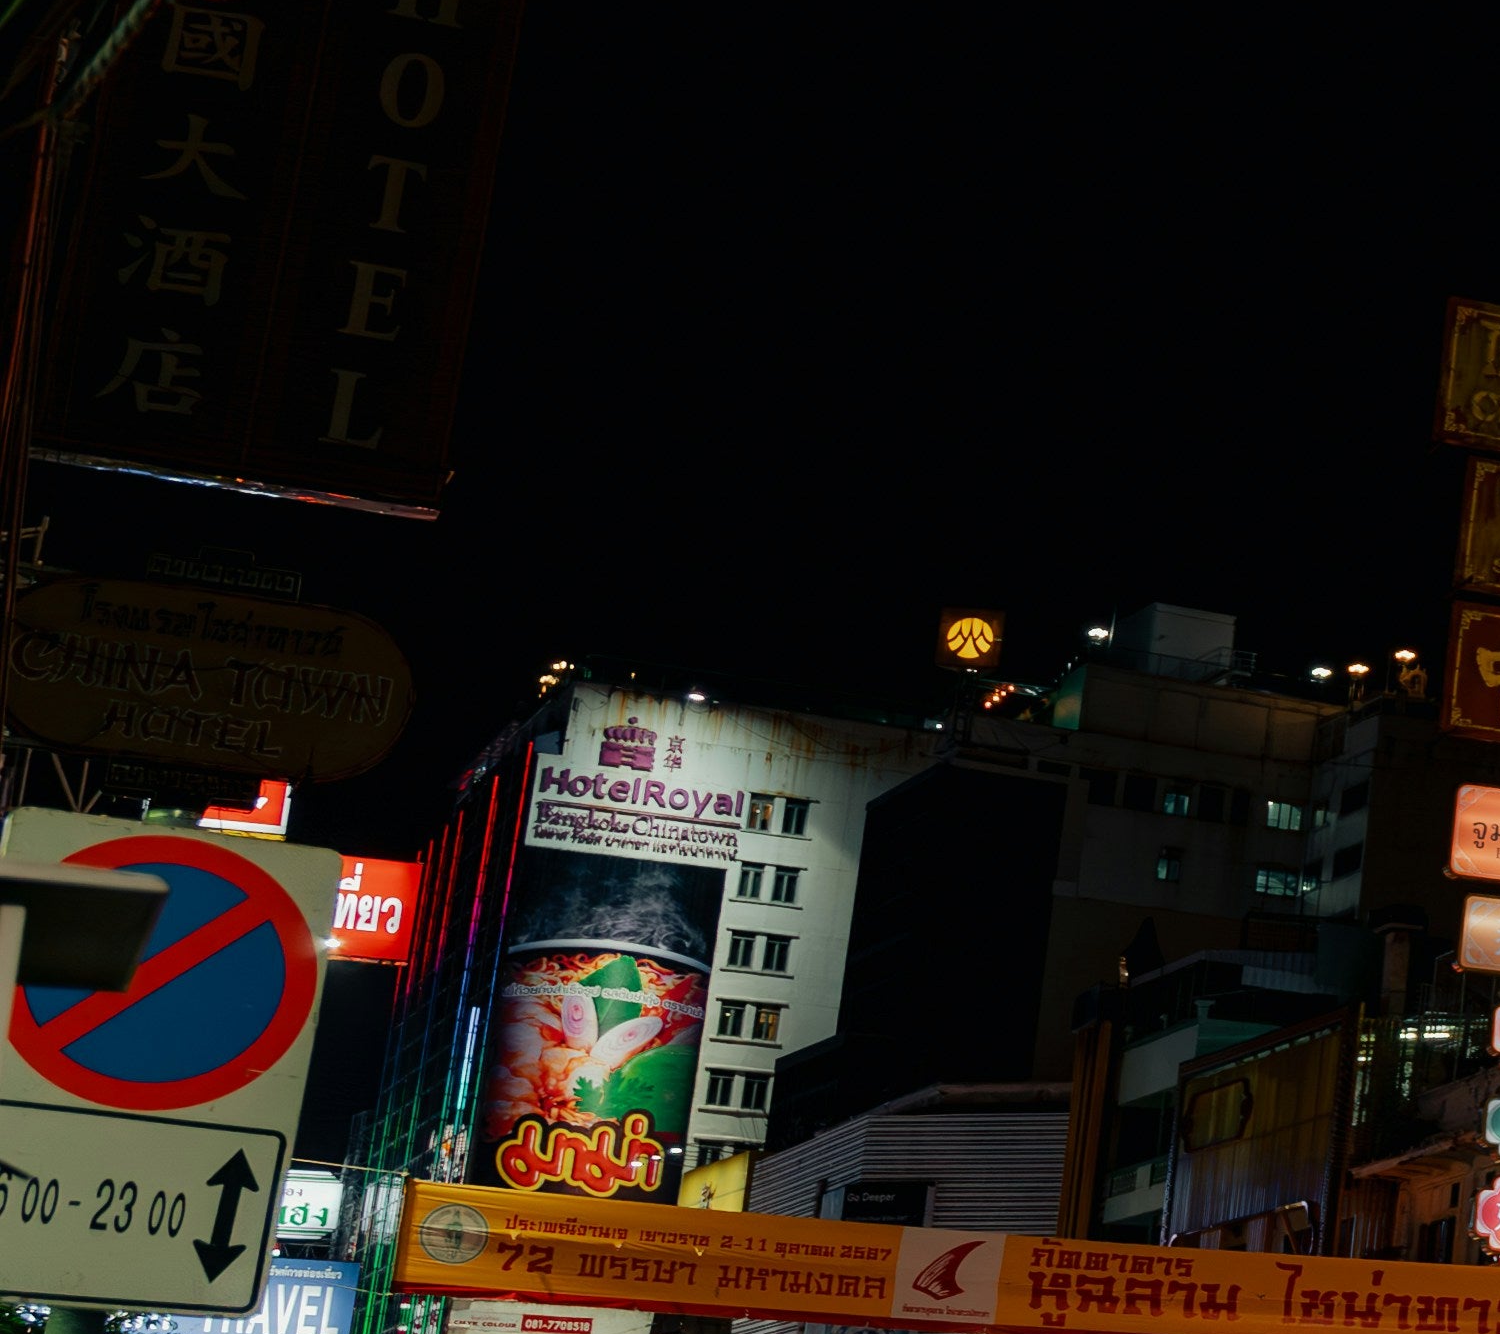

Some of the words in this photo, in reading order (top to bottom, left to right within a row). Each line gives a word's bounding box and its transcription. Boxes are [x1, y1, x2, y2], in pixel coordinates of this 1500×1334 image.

[9, 630, 203, 703] CHINA
[223, 656, 395, 726] TOWN
[100, 697, 284, 758] HOTEL
[498, 1115, 664, 1196] มาม่า
[862, 1192, 895, 1204] Deeper
[496, 1242, 553, 1275] 72
[578, 1252, 699, 1286] พรรษา
[718, 1264, 888, 1300] มหามงคล
[720, 1235, 767, 1253] 2-11
[1027, 1269, 1242, 1328] หูฉลาม
